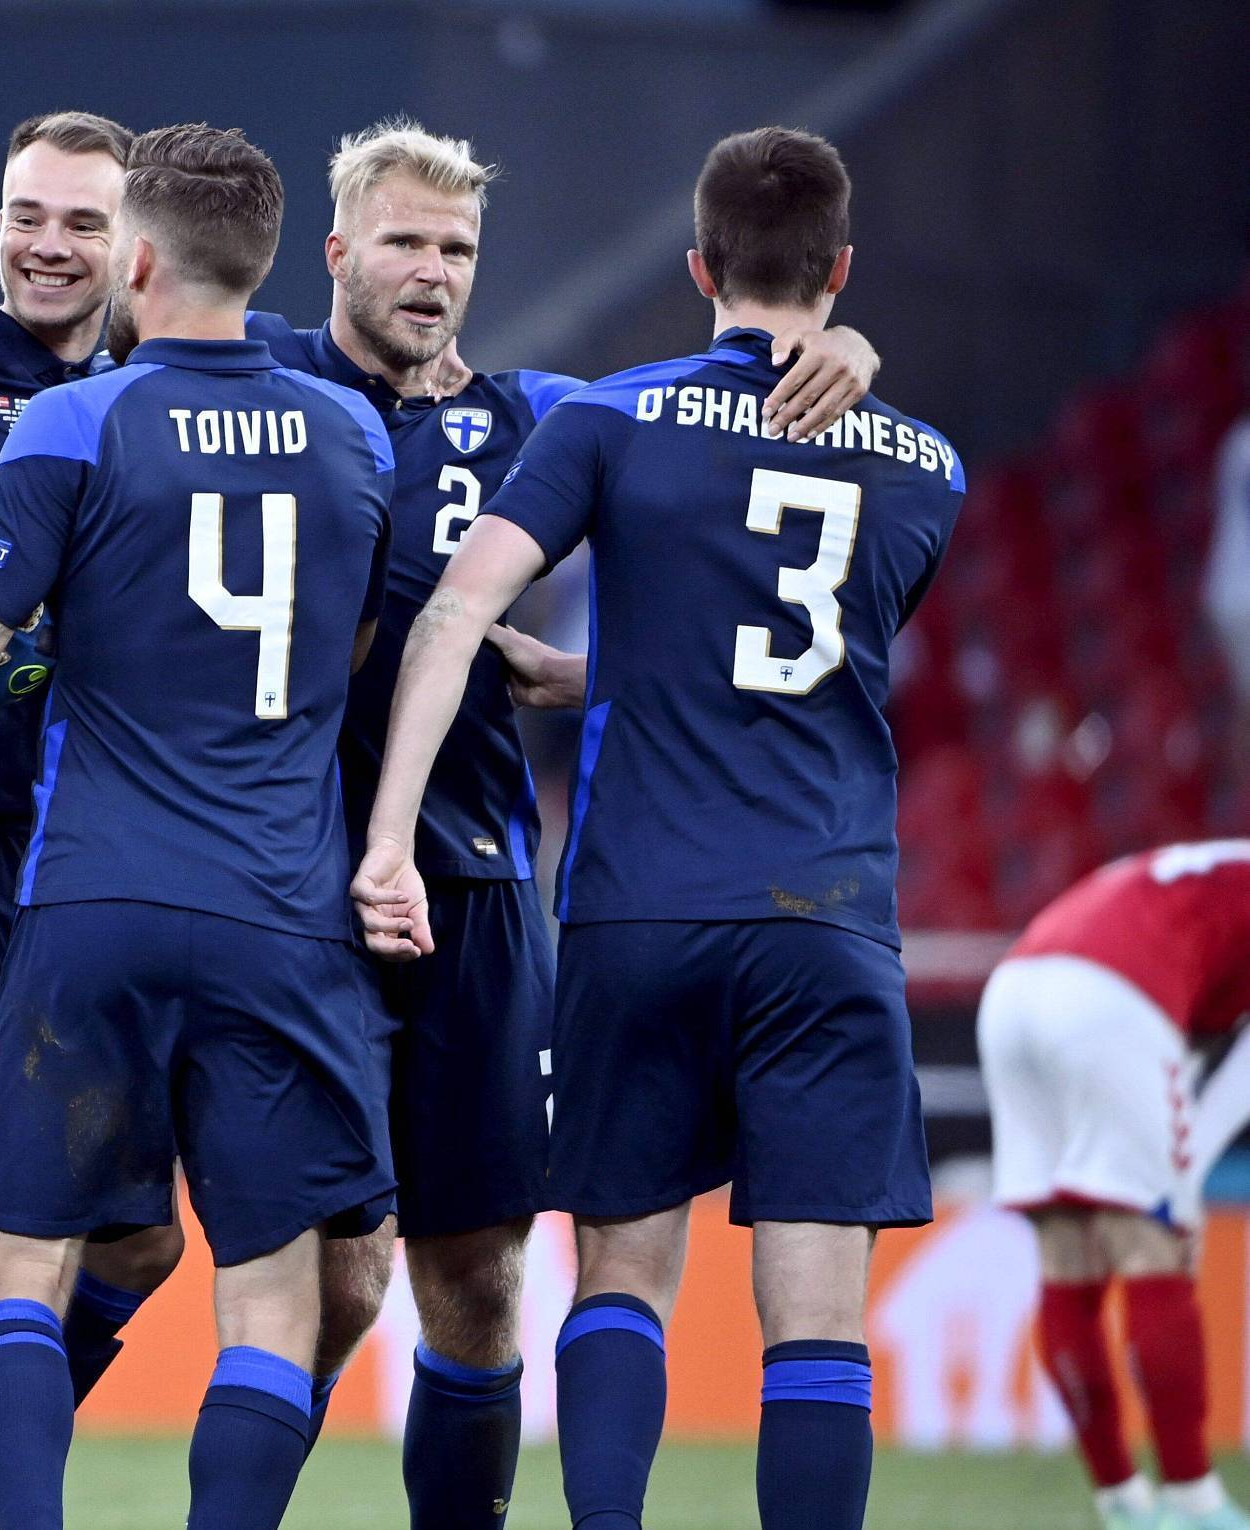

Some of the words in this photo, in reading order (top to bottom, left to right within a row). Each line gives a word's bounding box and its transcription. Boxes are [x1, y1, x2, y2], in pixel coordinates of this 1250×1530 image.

[169, 409, 308, 455] TOIVIO
[636, 386, 954, 480] O'SHAHNESSY
[432, 464, 482, 555] 2
[188, 493, 296, 719] 4
[733, 468, 862, 696] 3
